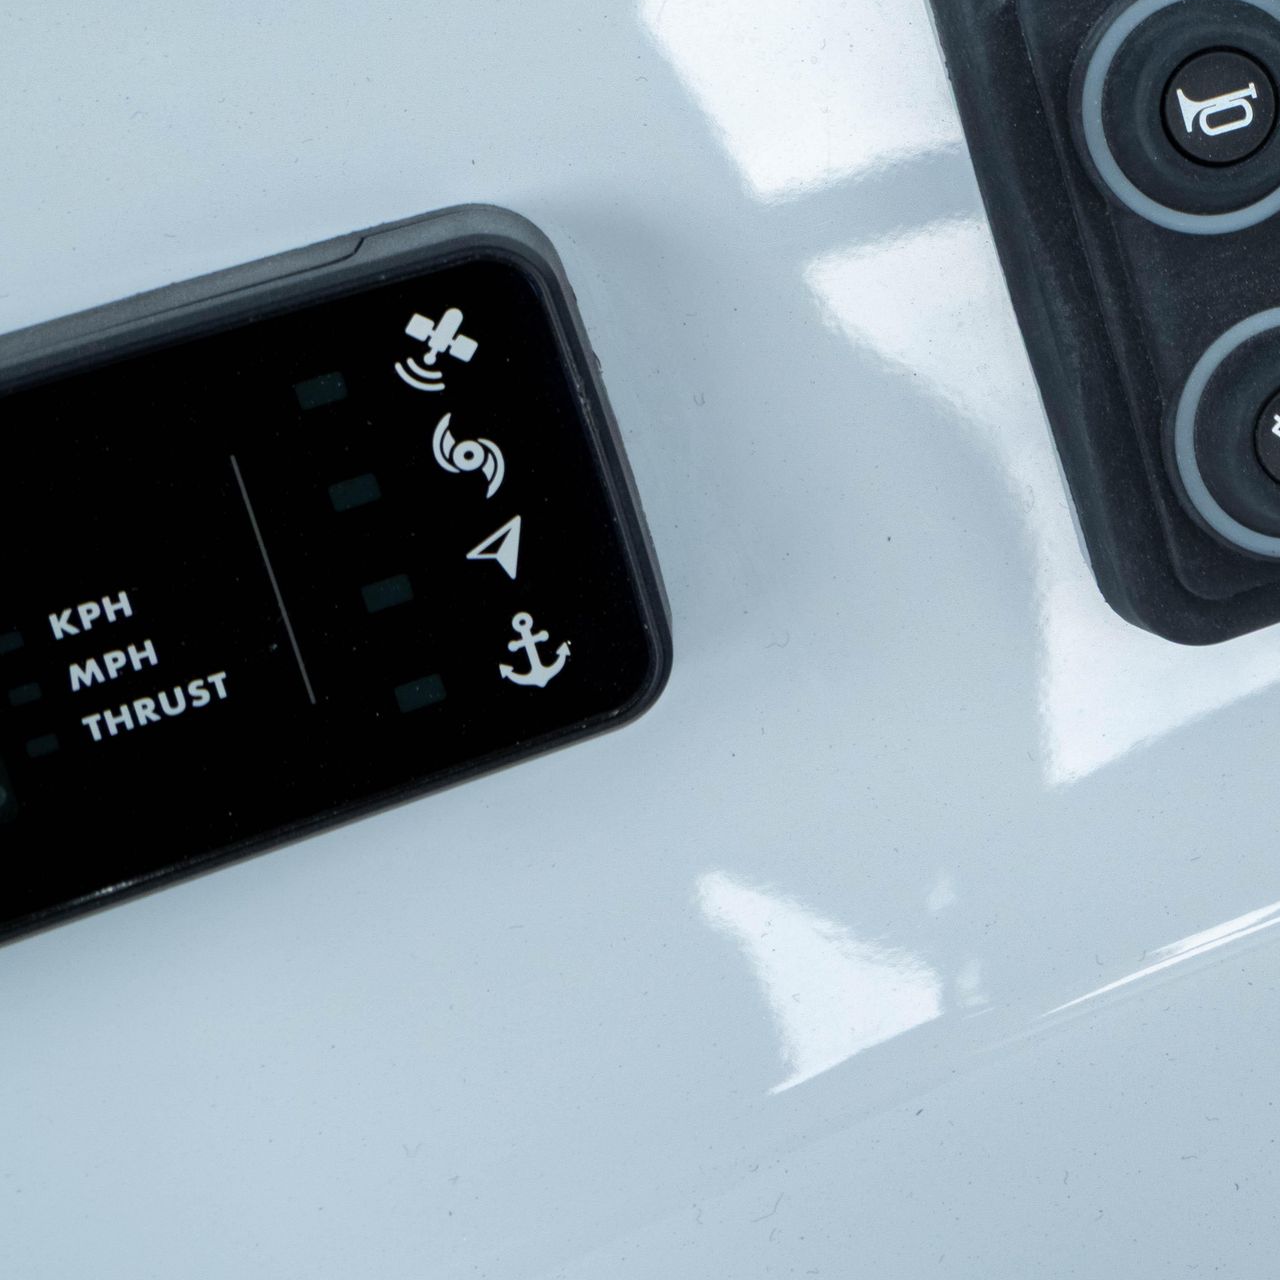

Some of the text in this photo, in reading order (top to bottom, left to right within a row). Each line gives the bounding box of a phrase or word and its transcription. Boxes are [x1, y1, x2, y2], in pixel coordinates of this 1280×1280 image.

[48, 590, 133, 640] KPH
[68, 639, 158, 692] MPH
[81, 671, 228, 741] THRUST
